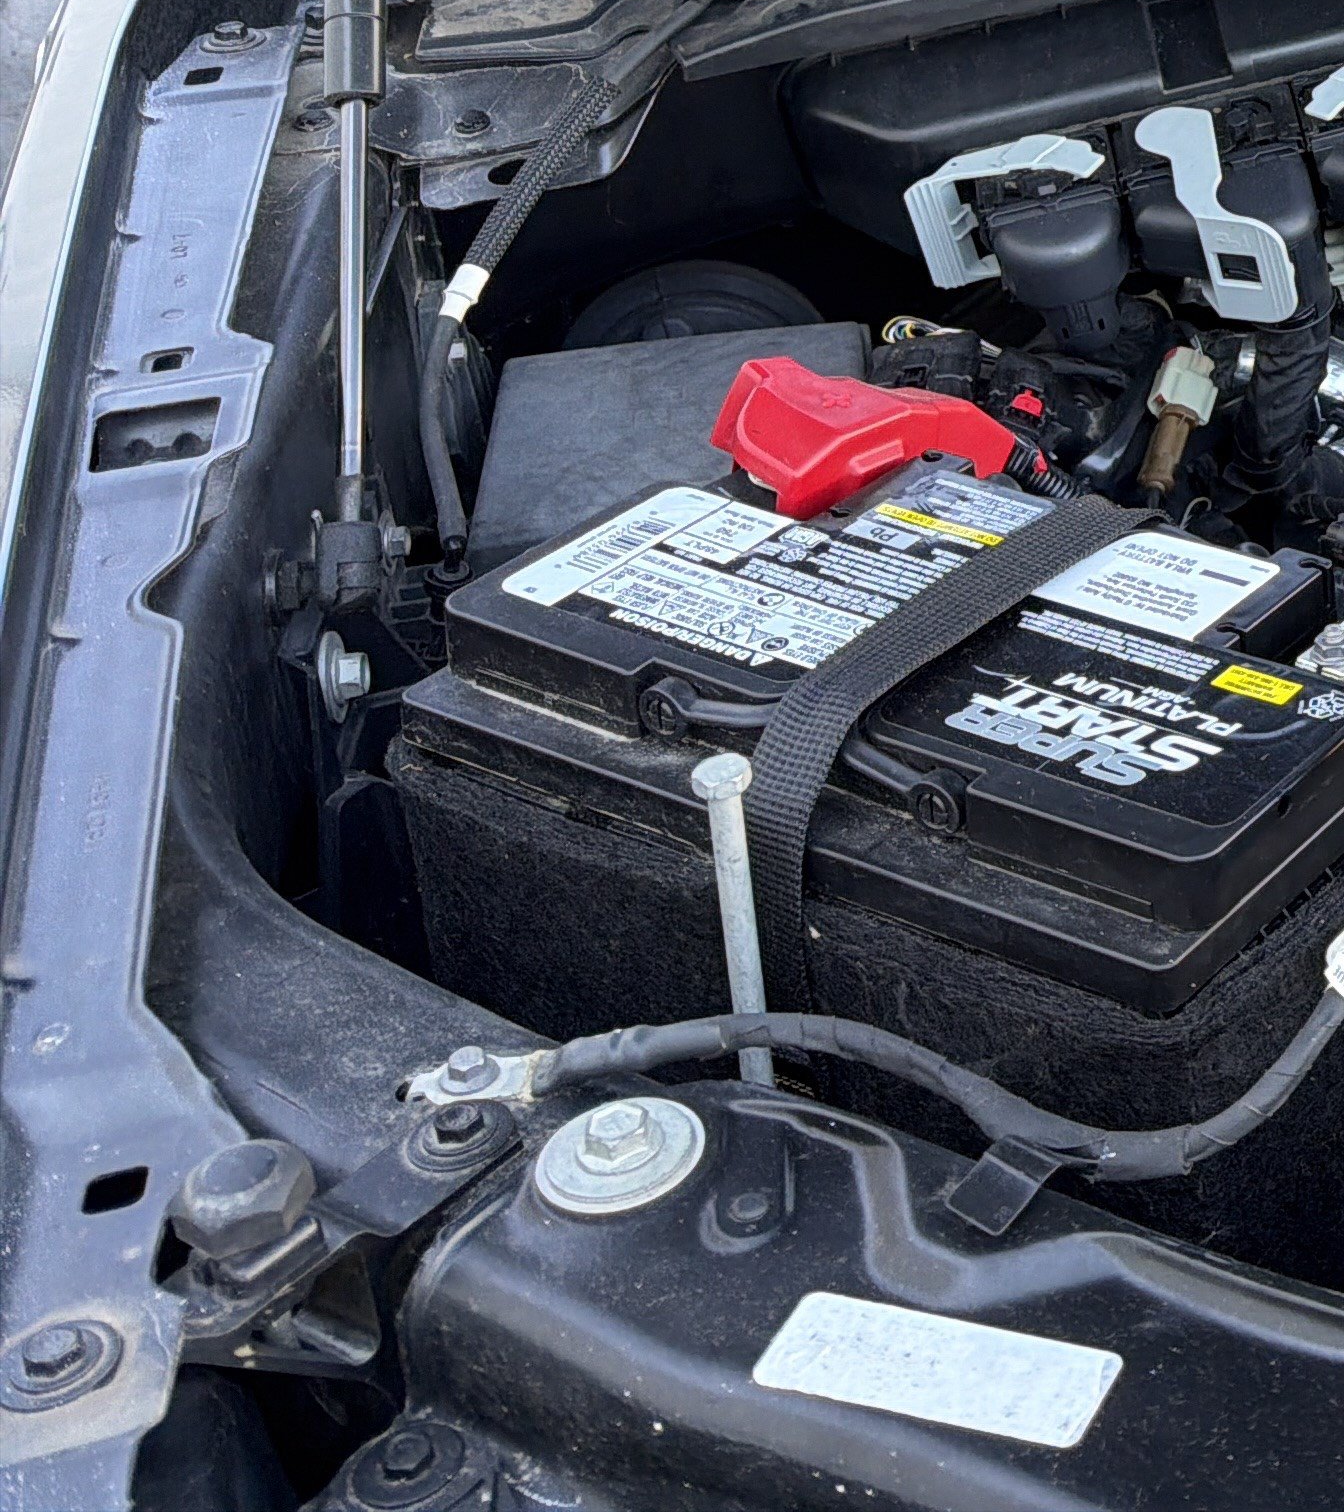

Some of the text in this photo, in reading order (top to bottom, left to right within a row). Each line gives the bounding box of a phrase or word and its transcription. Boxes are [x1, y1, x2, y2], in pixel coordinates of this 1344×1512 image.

[863, 525, 901, 543] Pb
[970, 682, 1224, 773] START
[1051, 672, 1243, 737] PLATINUM
[944, 700, 1149, 787] SUPER
